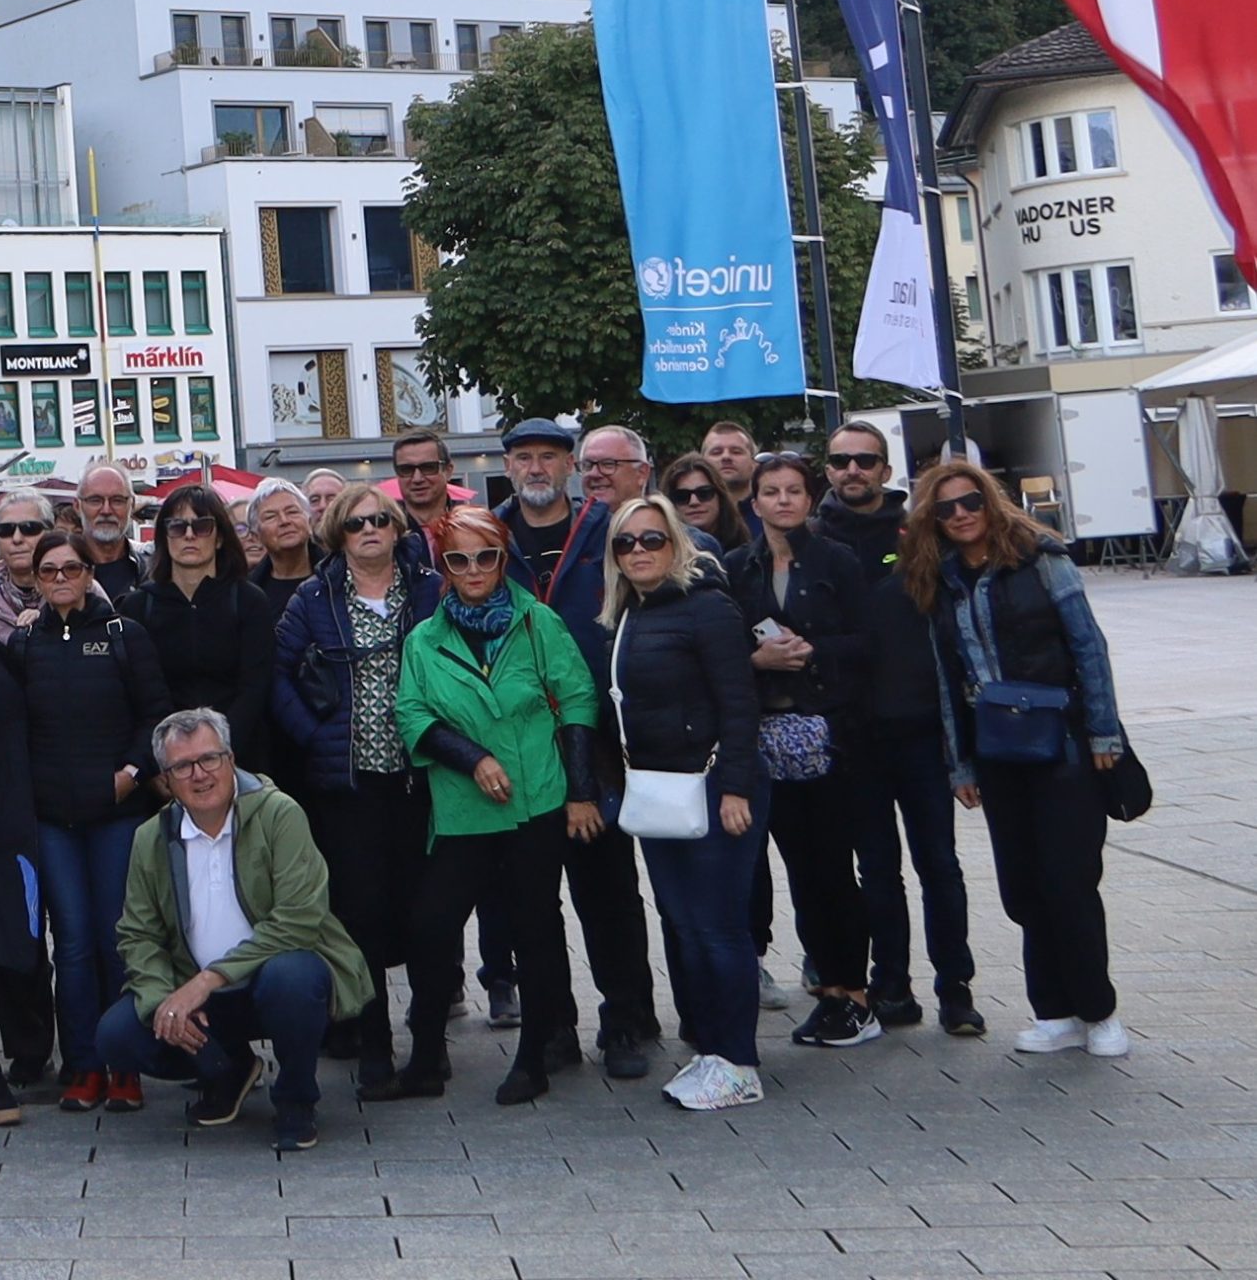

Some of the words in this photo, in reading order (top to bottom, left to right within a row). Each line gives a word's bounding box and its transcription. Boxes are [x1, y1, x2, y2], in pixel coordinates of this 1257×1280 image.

[1015, 196, 1115, 226] VADOZNER
[6, 355, 79, 370] MONTBLANC
[125, 345, 204, 368] märklin
[83, 641, 109, 652] EA7
